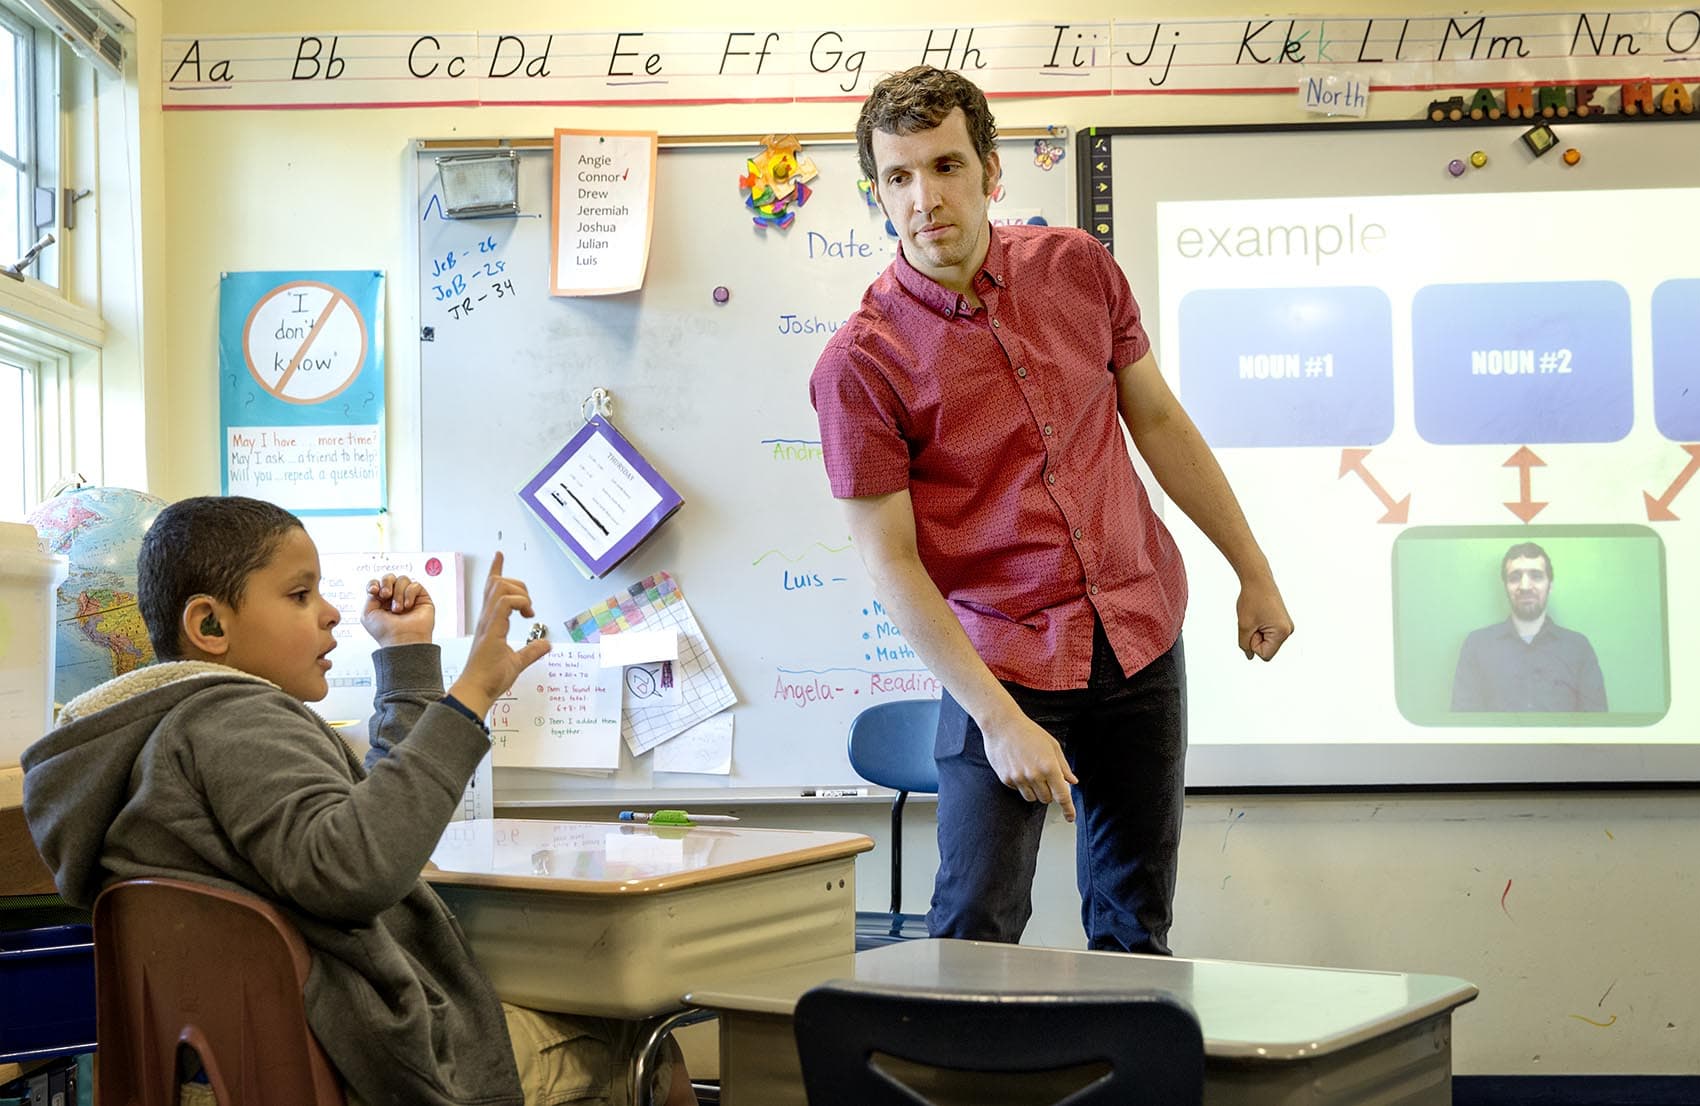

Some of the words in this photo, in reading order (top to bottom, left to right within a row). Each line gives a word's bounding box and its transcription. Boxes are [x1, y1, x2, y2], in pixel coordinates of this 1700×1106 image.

[169, 40, 233, 82] Aa
[292, 37, 345, 81] Bb
[408, 36, 465, 78] Cc
[488, 35, 552, 78] Dd
[608, 33, 662, 76] Ee
[719, 32, 778, 74] Ff
[810, 31, 865, 92] Gg
[920, 29, 986, 70] Hh
[1127, 23, 1180, 86] Jj
[1438, 17, 1530, 60] Mm
[1570, 13, 1639, 56] Nn
[1307, 77, 1364, 107] North
[578, 155, 611, 168] Angie
[578, 171, 620, 182] Connor
[578, 188, 608, 199] Drew
[577, 205, 629, 216] Jeremiah
[577, 221, 616, 233] Joshua
[577, 238, 608, 249] Julian
[1177, 213, 1386, 266] example
[576, 255, 598, 266] Luis
[432, 274, 466, 301] JoB
[448, 297, 474, 320] JR
[492, 279, 515, 298] 34
[1239, 354, 1300, 379] NOUN
[1304, 353, 1334, 378] #1
[1472, 350, 1534, 375] NOUN
[1539, 349, 1572, 374] #2
[232, 434, 256, 454] May
[273, 431, 296, 447] have
[318, 436, 343, 446] more
[232, 452, 250, 469] May
[265, 450, 285, 464] ask
[230, 468, 249, 481] Will
[254, 471, 272, 487] you
[784, 570, 824, 591] Luis
[876, 644, 915, 662] Math
